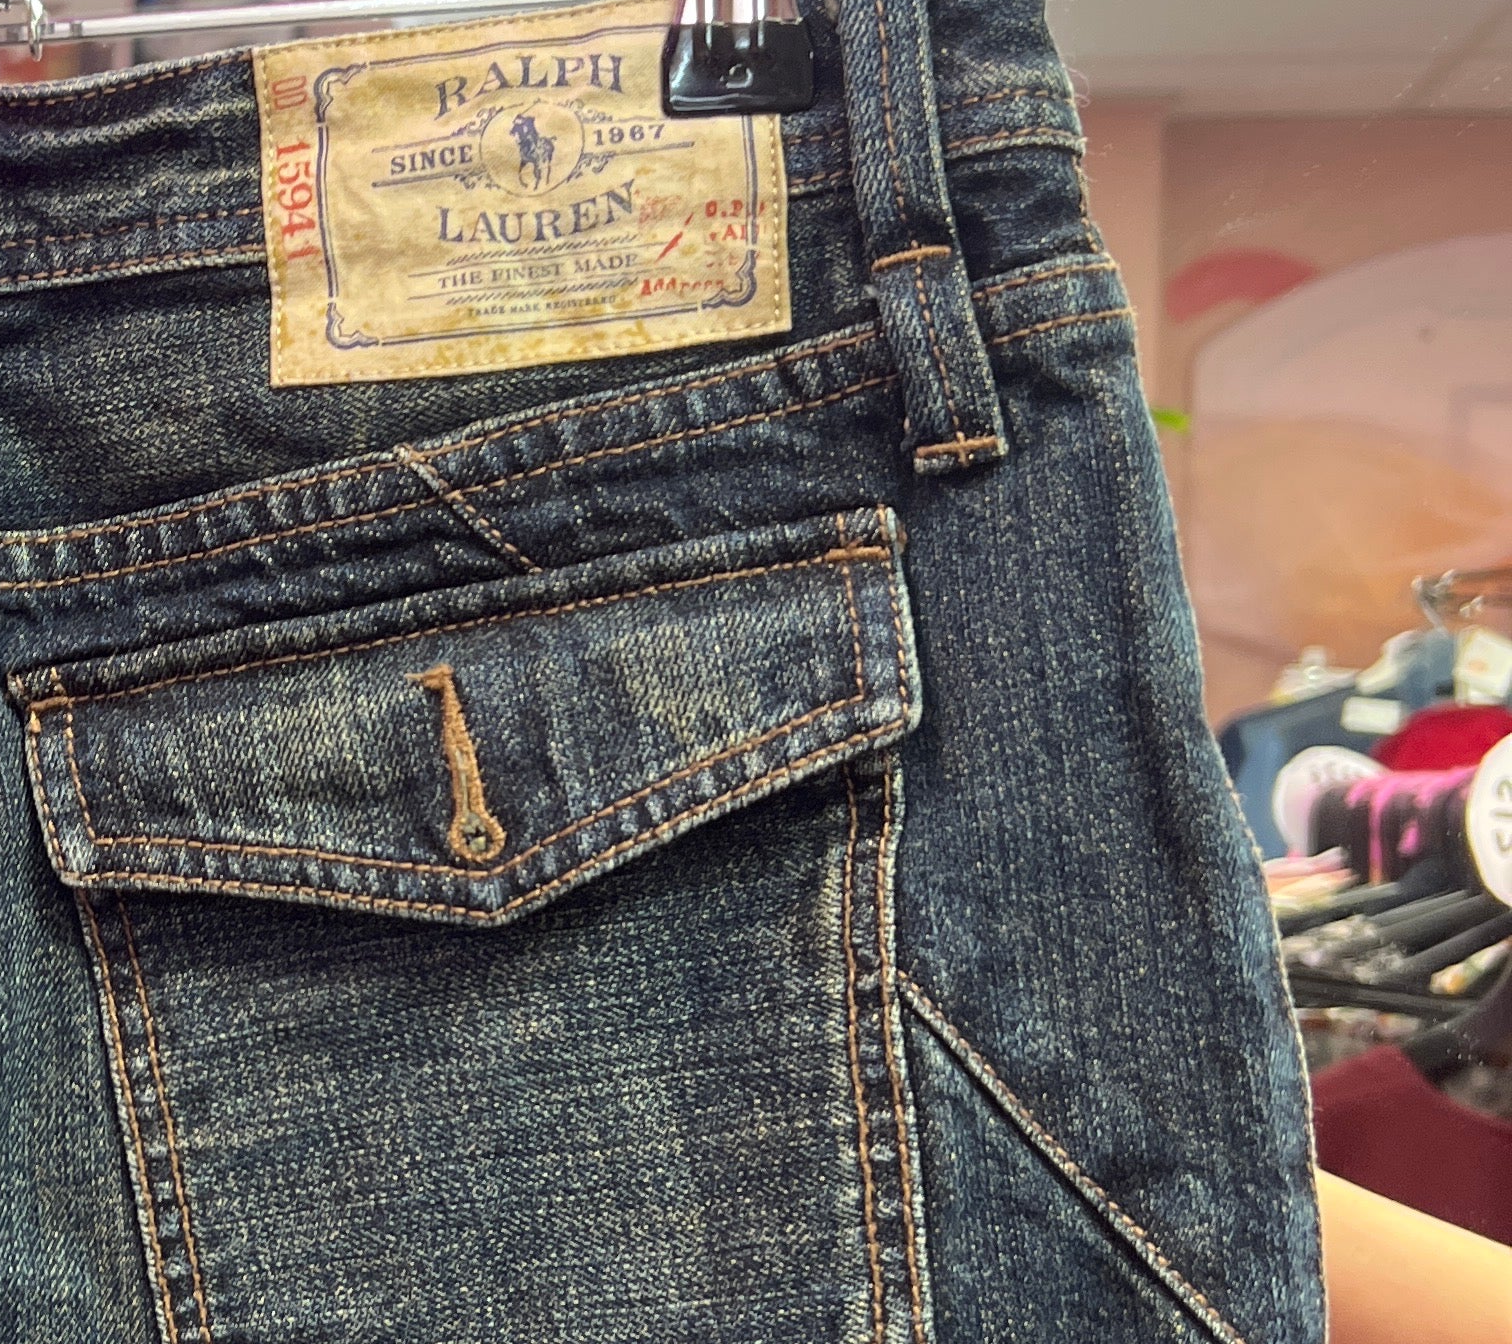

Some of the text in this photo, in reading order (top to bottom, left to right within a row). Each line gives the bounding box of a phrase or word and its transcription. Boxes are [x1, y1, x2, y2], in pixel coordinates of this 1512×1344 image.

[434, 53, 624, 122] RALPH
[390, 123, 666, 177] SINCE 1967
[436, 178, 636, 244] LAUREN
[438, 252, 639, 290] THE FINEST MADE
